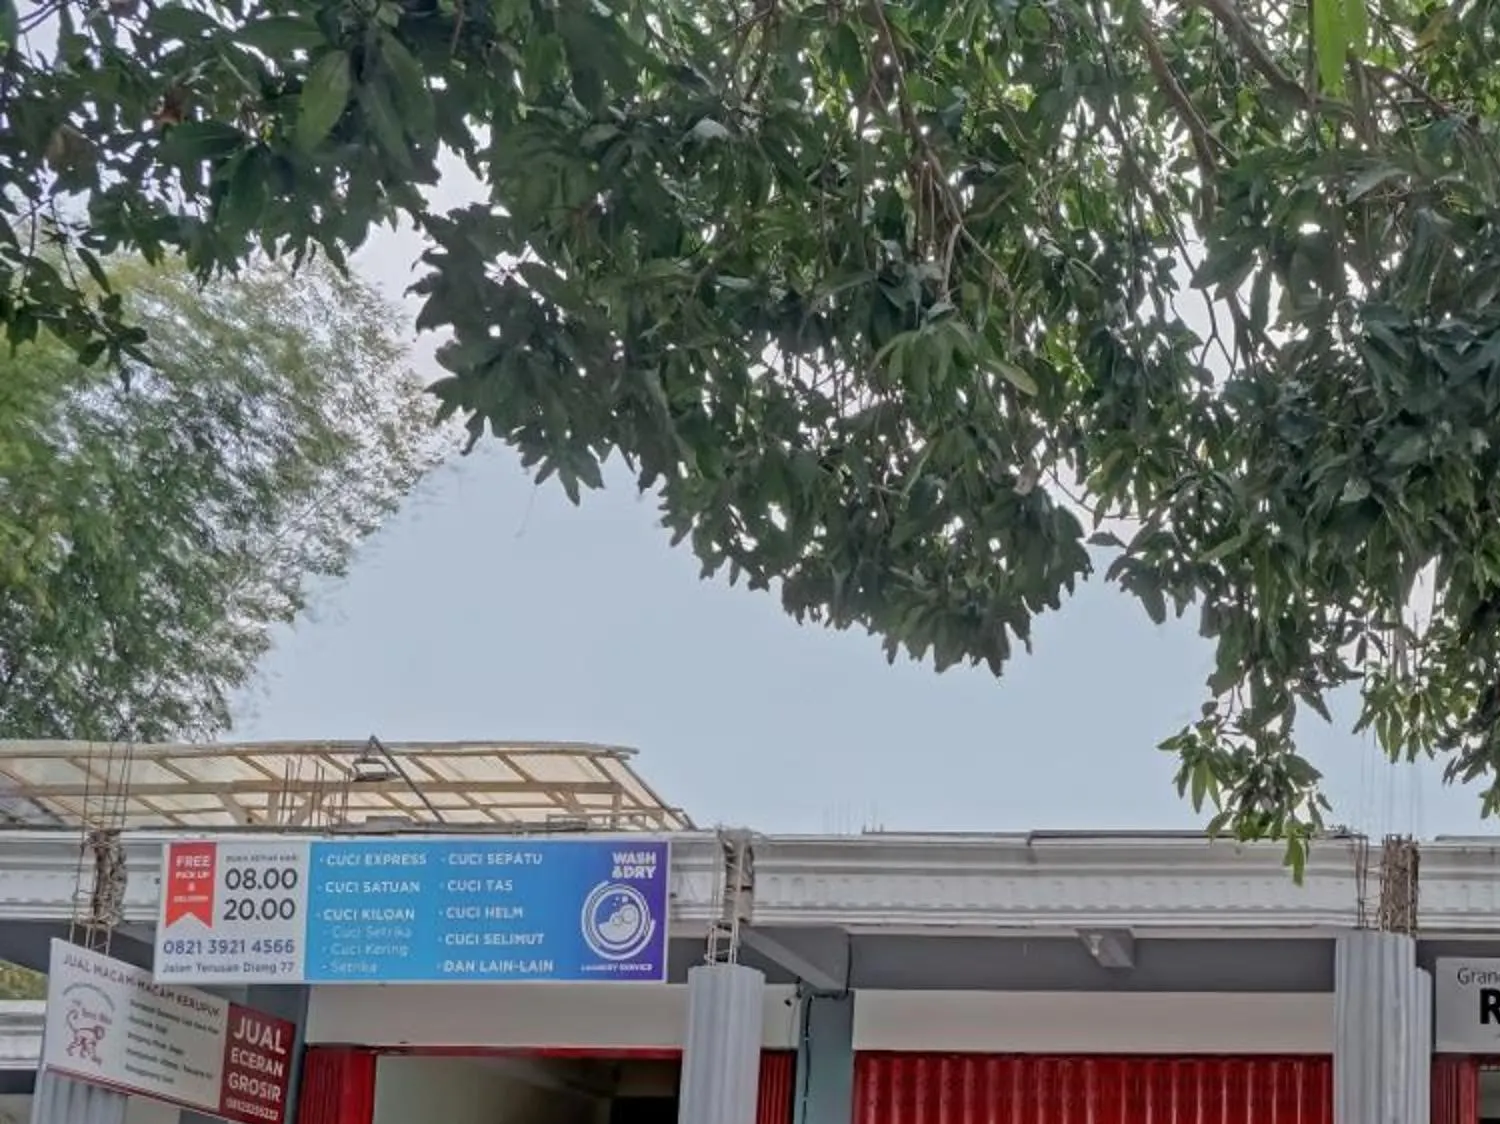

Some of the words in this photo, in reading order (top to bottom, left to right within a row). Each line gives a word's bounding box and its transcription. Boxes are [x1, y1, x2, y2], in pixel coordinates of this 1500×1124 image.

[176, 855, 212, 868] FREE
[327, 853, 360, 866] CUCI
[364, 853, 428, 866] EXPRESS
[448, 853, 483, 866] CUCI
[487, 853, 543, 866] SEPATU
[612, 852, 657, 865] WASH
[225, 868, 298, 890] 08.00
[611, 866, 657, 879] &DRY
[325, 881, 360, 893] CUCI
[363, 881, 420, 893] SATUAN
[447, 880, 481, 892] CUCI
[486, 880, 513, 892] TAS
[223, 898, 296, 920] 20.00
[323, 908, 357, 921] CUCI
[360, 908, 415, 921] KILOAN
[446, 906, 480, 919] CUCI
[484, 907, 523, 919] HELM
[445, 933, 479, 946] CUCI
[483, 933, 545, 946] SELIMUT
[163, 938, 203, 955] 0821
[207, 939, 246, 955] 3921
[64, 953, 90, 971] JUAL
[280, 962, 295, 973] 77
[443, 960, 476, 973] DAN
[480, 960, 554, 973] LAIN-LAIN
[233, 1016, 286, 1055] JUAL
[231, 1047, 285, 1077] ECERAN
[228, 1072, 281, 1102] GROSIR
